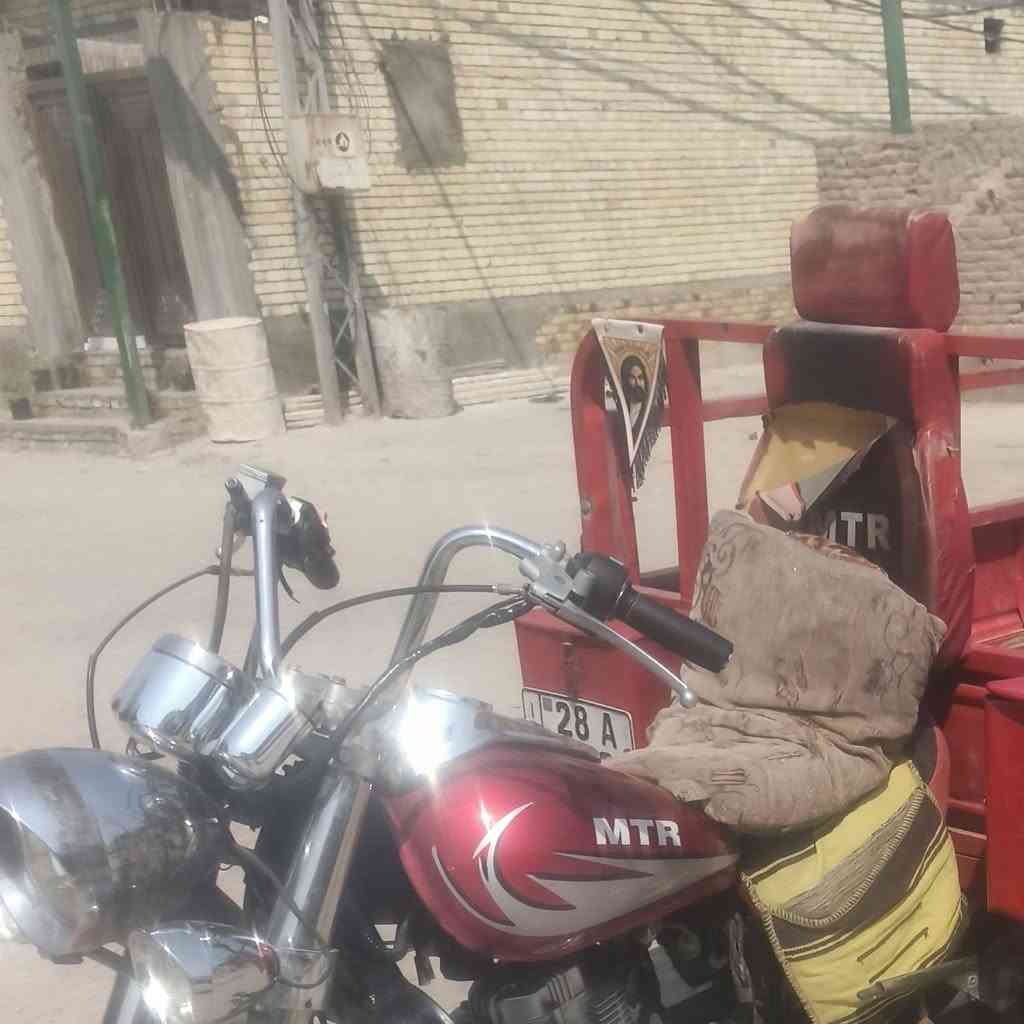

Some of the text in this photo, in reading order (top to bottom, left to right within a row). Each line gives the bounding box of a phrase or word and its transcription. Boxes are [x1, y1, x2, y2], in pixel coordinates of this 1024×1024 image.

[555, 701, 617, 749] 28 A
[592, 817, 682, 847] MTR
